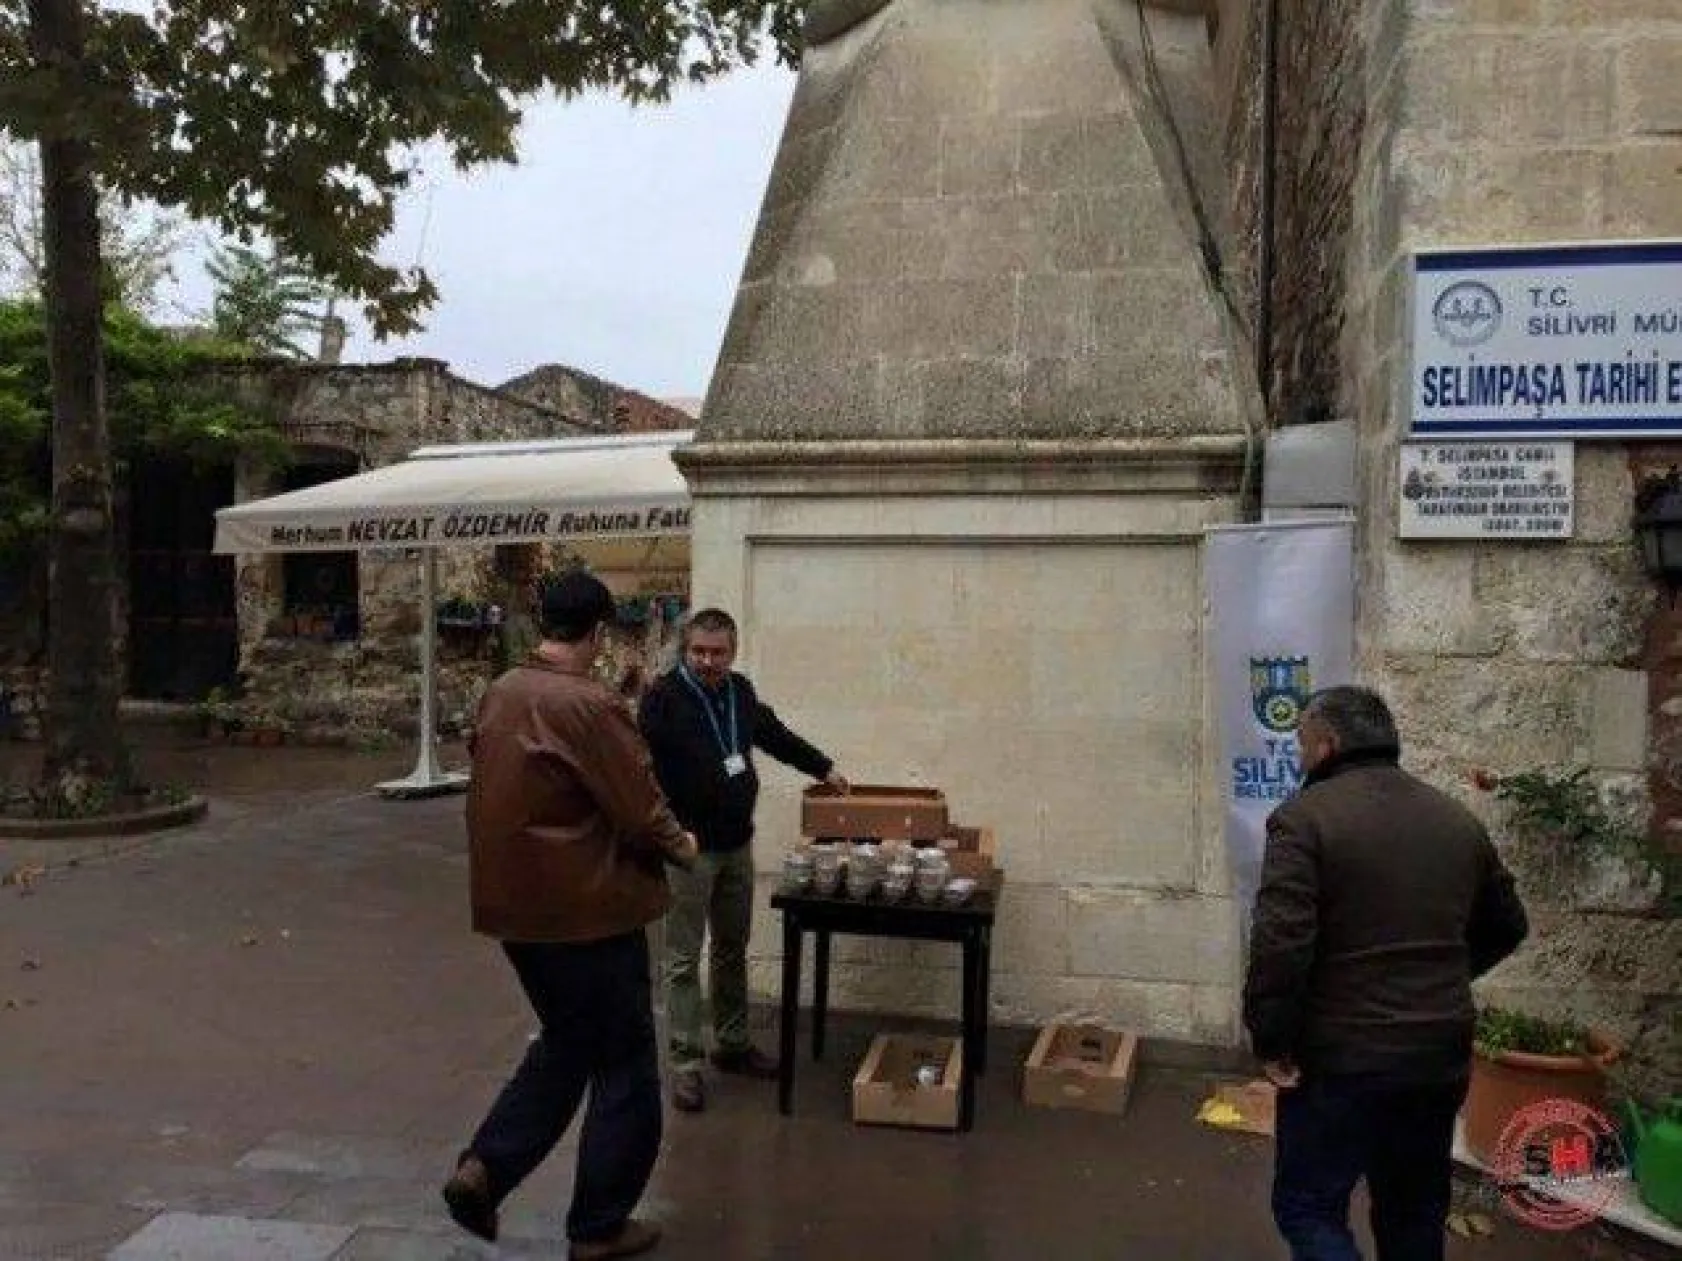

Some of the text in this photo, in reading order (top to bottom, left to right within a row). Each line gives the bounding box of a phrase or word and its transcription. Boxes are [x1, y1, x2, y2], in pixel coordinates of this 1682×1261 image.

[1529, 287, 1572, 308] T.C.
[1423, 352, 1567, 419] SELİMPAŞA
[1577, 349, 1658, 404] TARİHİ
[347, 515, 434, 543] NEVZAT
[443, 506, 551, 537] ÖZDEMİR
[557, 510, 640, 534] Ruhuna
